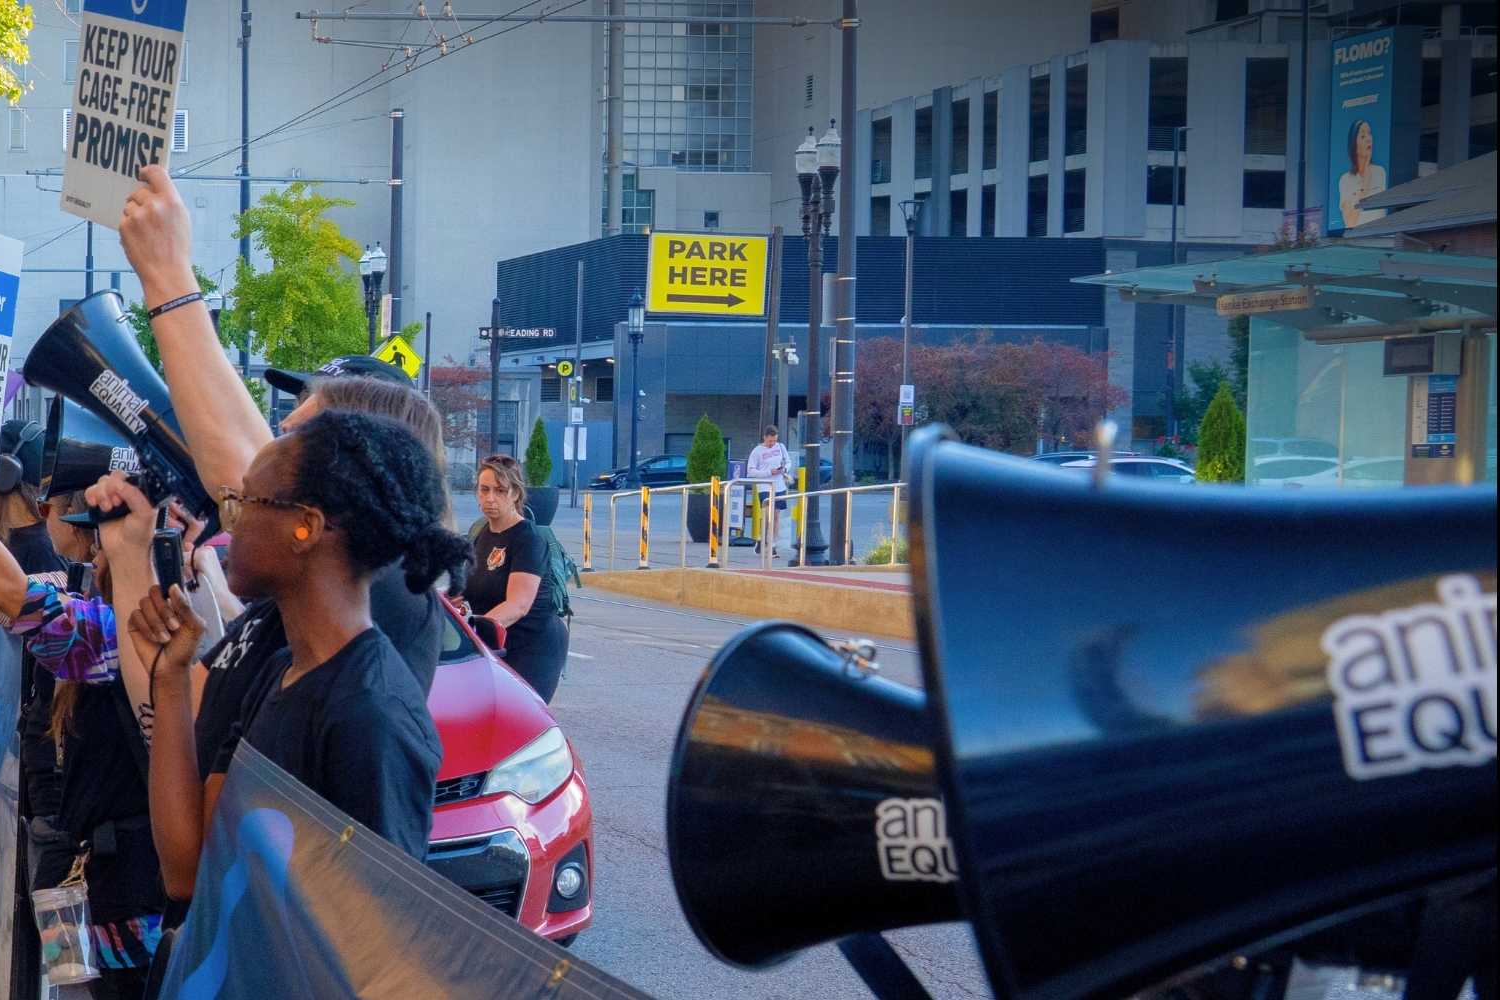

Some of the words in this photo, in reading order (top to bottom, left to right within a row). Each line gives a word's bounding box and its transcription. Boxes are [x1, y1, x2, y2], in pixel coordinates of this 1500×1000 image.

[83, 23, 129, 71] KEEP
[131, 34, 177, 84] YOUR
[1334, 36, 1391, 65] FLOMO?
[79, 68, 171, 131] CAGE-FREE
[668, 240, 749, 261] PARK
[668, 265, 748, 287] HERE
[1280, 294, 1308, 305] Station
[543, 328, 555, 337] RD
[92, 381, 145, 433] EQUALITY
[101, 370, 148, 415] animal
